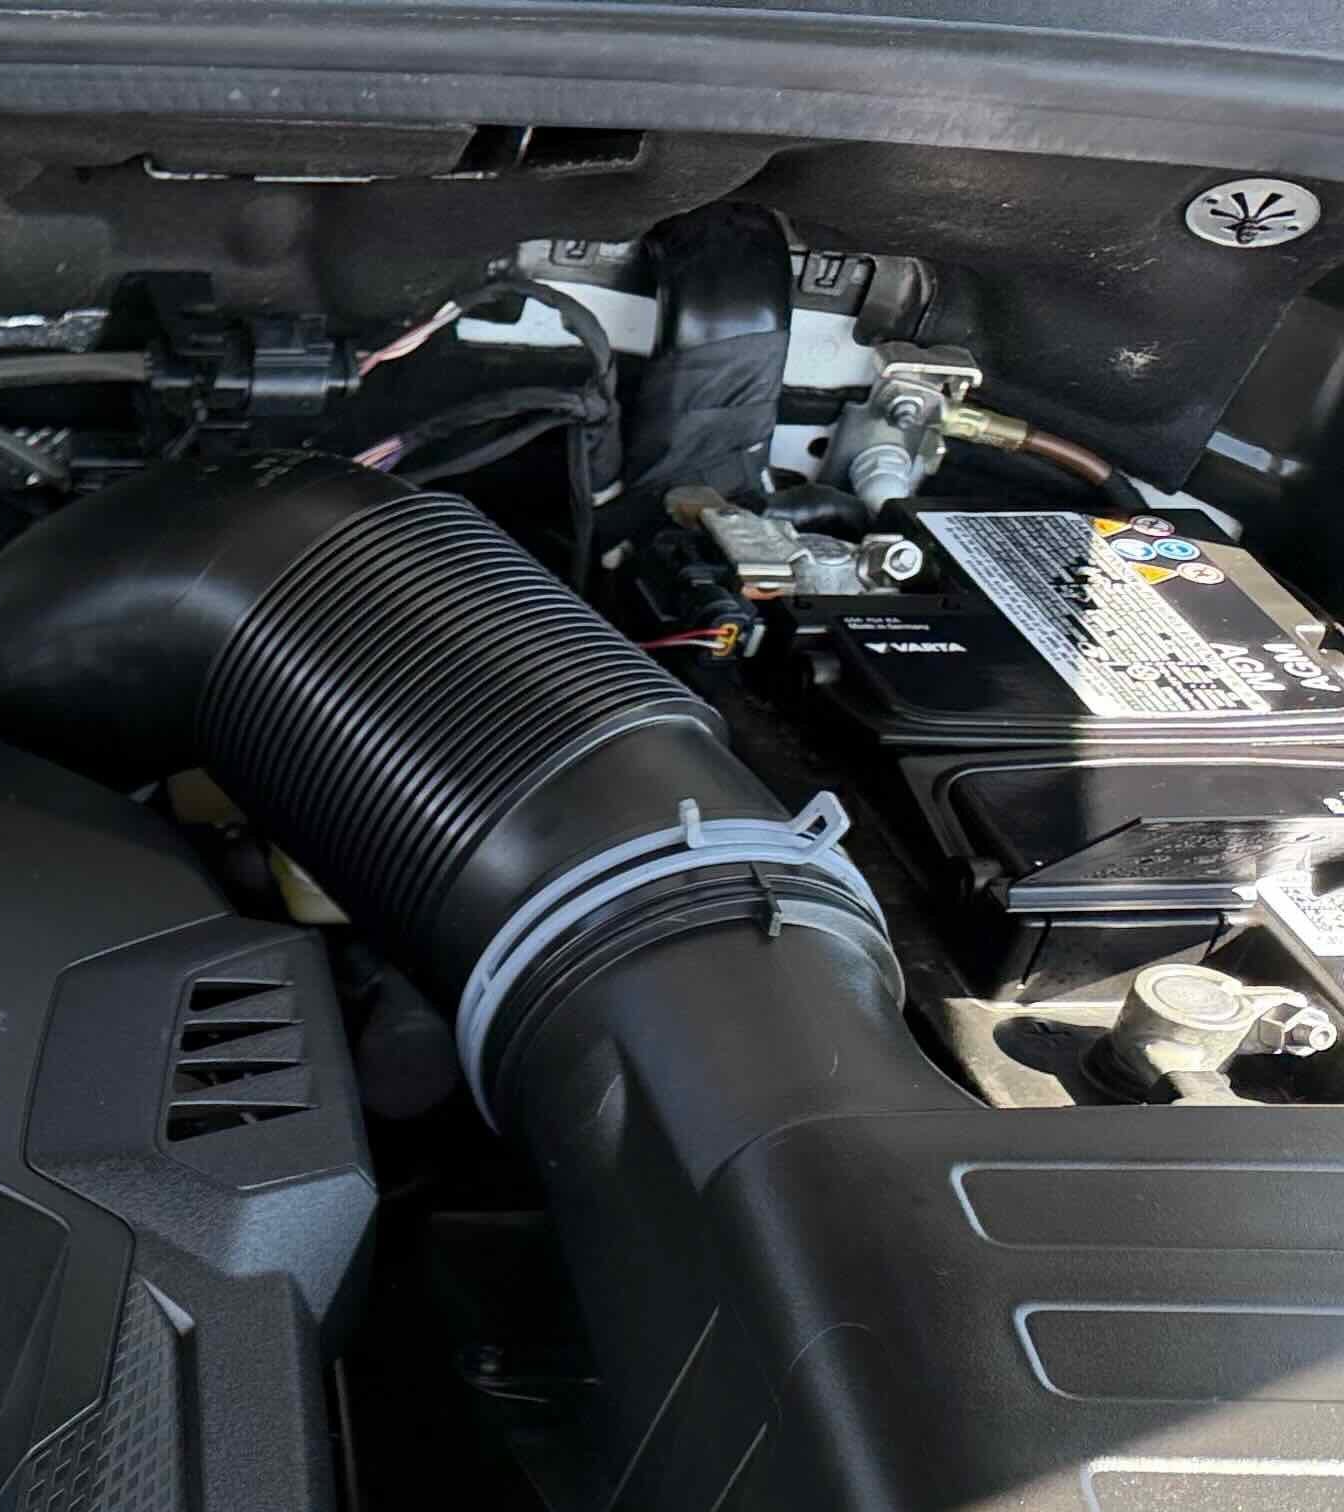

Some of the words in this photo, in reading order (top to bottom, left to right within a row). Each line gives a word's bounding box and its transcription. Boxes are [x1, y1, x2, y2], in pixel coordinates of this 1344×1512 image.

[889, 642, 968, 653] VARTA
[1209, 642, 1288, 691] AGM
[1262, 643, 1343, 692] AGM
